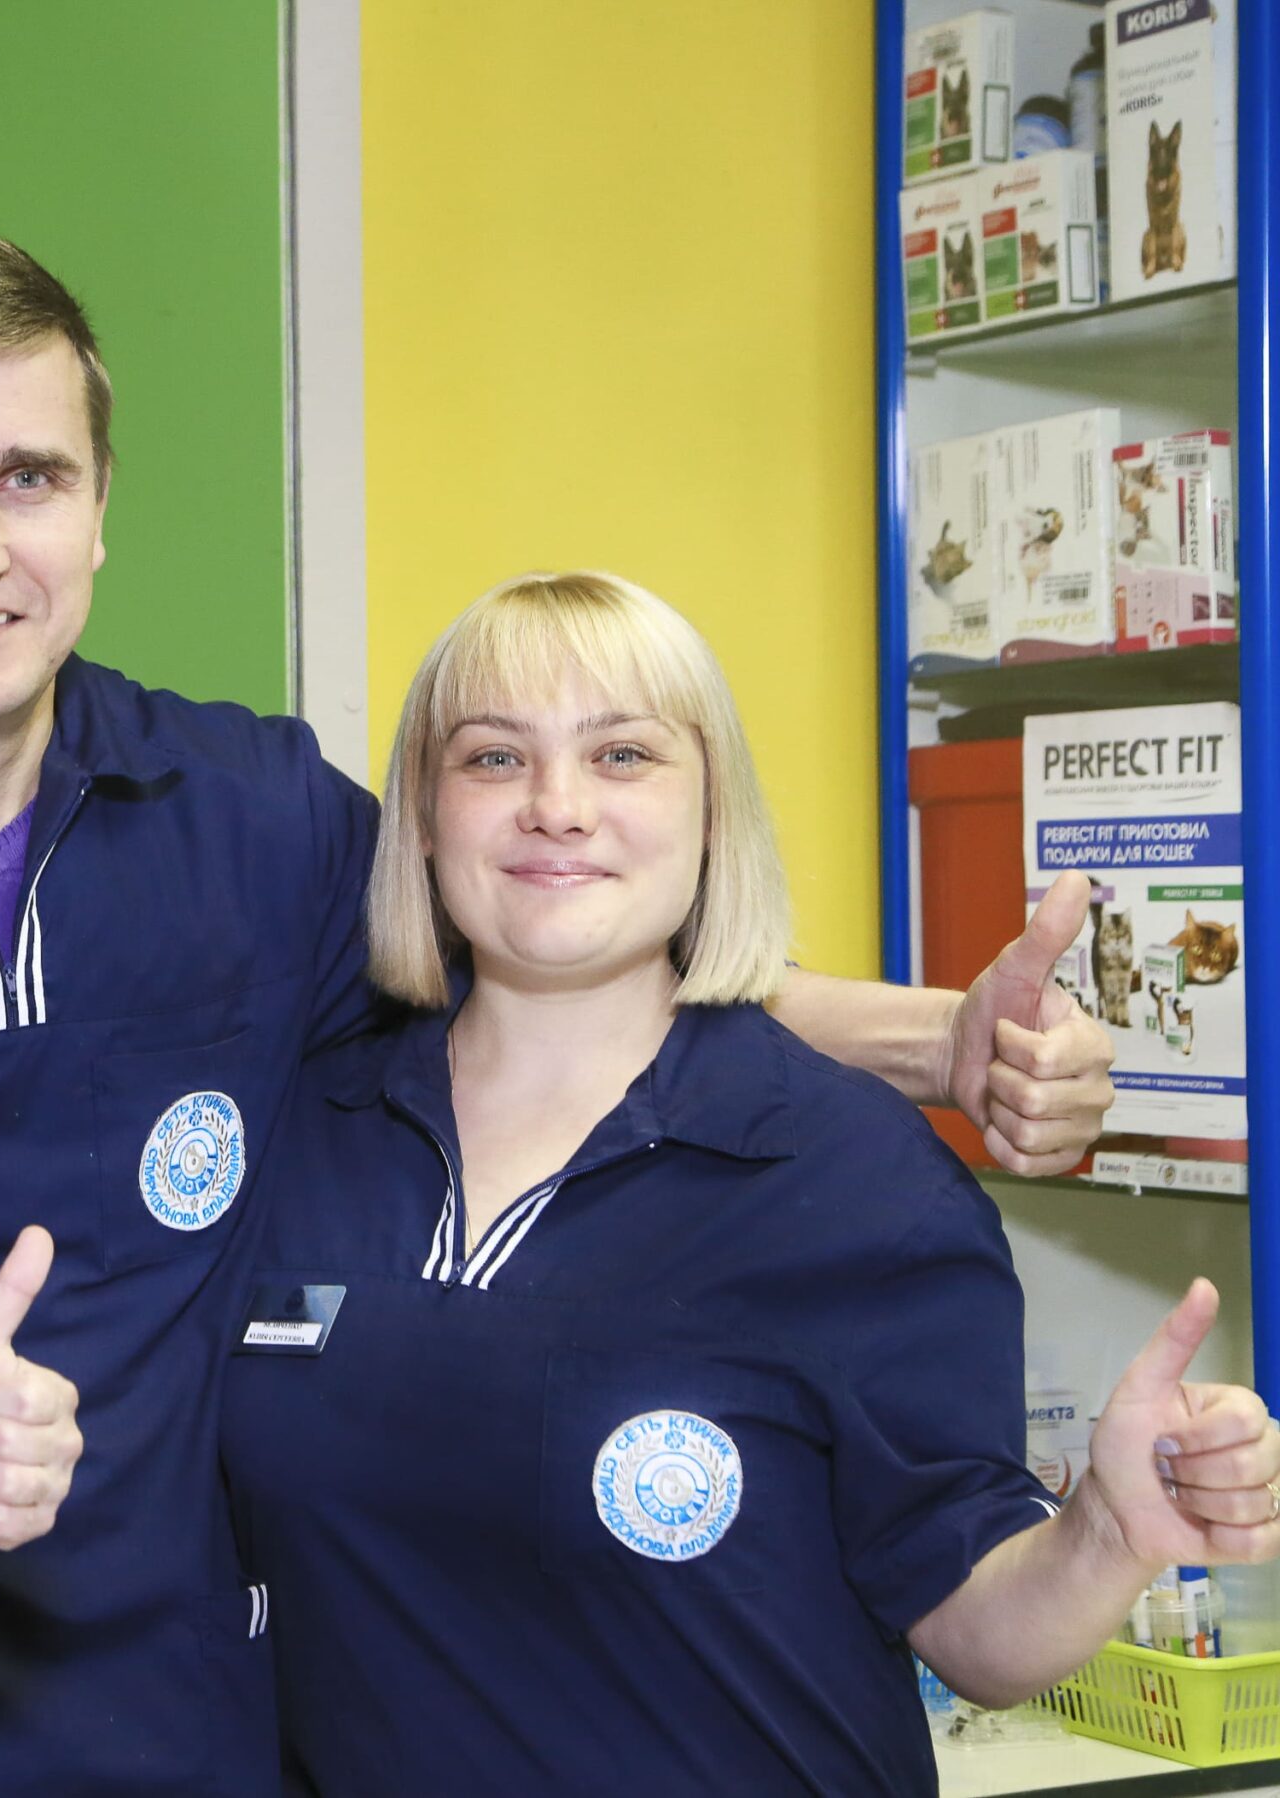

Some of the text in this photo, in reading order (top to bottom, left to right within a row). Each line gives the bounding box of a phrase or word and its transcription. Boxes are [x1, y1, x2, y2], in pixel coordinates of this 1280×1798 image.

[1126, 0, 1188, 36] KORIS
[1044, 735, 1223, 780] PERFECT FIT
[1043, 825, 1095, 843] PERFECT
[1119, 821, 1210, 840] ПРИГОТОВИЛ
[1043, 843, 1194, 865] ПОДАРКИ ДЛЯ КОШЕК
[158, 1104, 189, 1139] СЕТЬ
[1025, 1406, 1075, 1420] мекта
[616, 1415, 732, 1461] СЕТЬ КЛИНИК
